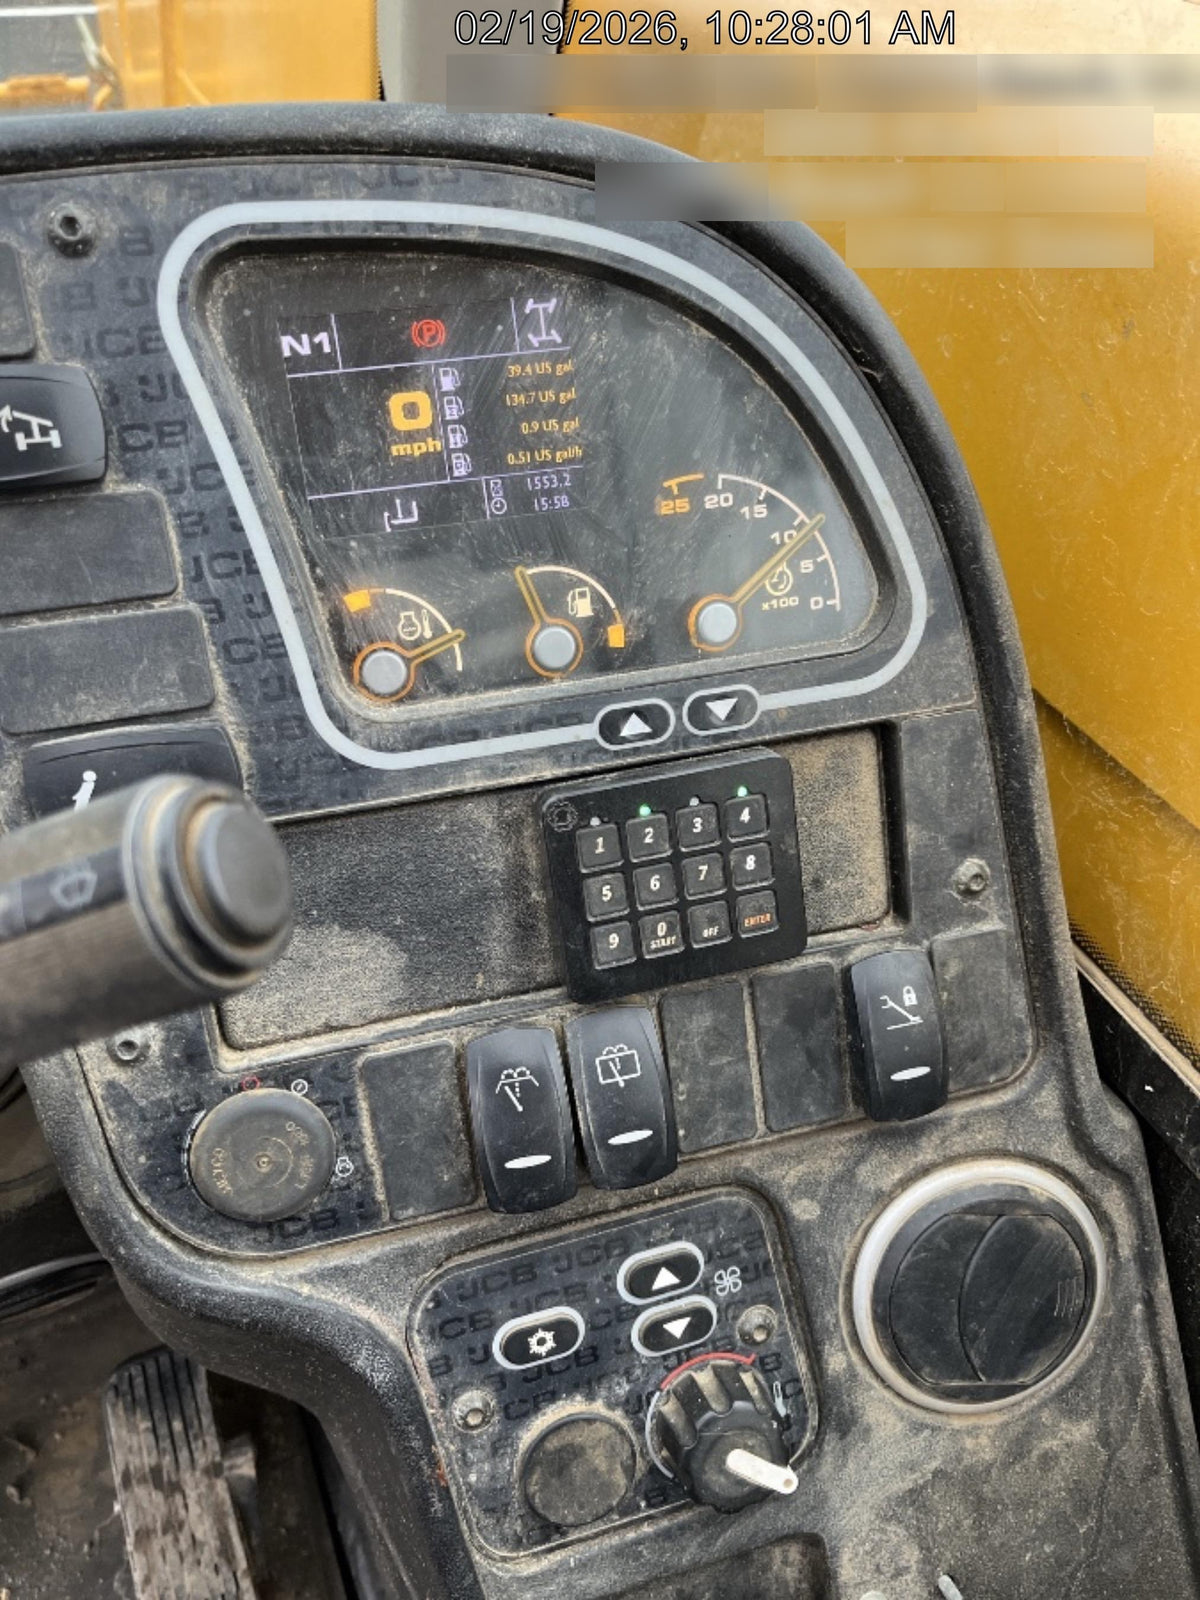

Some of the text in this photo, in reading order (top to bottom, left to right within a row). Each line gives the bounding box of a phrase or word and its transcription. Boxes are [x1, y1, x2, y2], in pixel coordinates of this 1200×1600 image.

[280, 332, 332, 358] N1
[508, 358, 574, 378] 39.4 US gal
[538, 390, 556, 403] US
[559, 387, 577, 405] gal
[388, 390, 433, 431] 0
[521, 416, 580, 435] 0.9 US gal
[390, 437, 442, 457] mph
[507, 445, 583, 465] 0.51 US gal/h
[527, 473, 572, 491] 1553.2
[535, 495, 570, 511] 15:58
[660, 497, 690, 516] 25
[703, 492, 734, 509] 20
[740, 504, 768, 520] 15
[770, 529, 798, 545] 10
[800, 560, 814, 574] 5
[761, 596, 799, 611] x100
[810, 596, 824, 610] 0
[739, 806, 751, 824] 4
[692, 816, 703, 833] 3
[643, 827, 654, 844] 2
[595, 836, 605, 854] 1
[745, 854, 757, 871] 8
[697, 864, 709, 881] 7
[650, 874, 661, 891] 6
[601, 884, 613, 902] 5
[743, 913, 771, 927] ENTER
[656, 921, 668, 937] 0
[702, 926, 720, 939] OFF
[608, 932, 620, 949] 9
[649, 936, 677, 950] START
